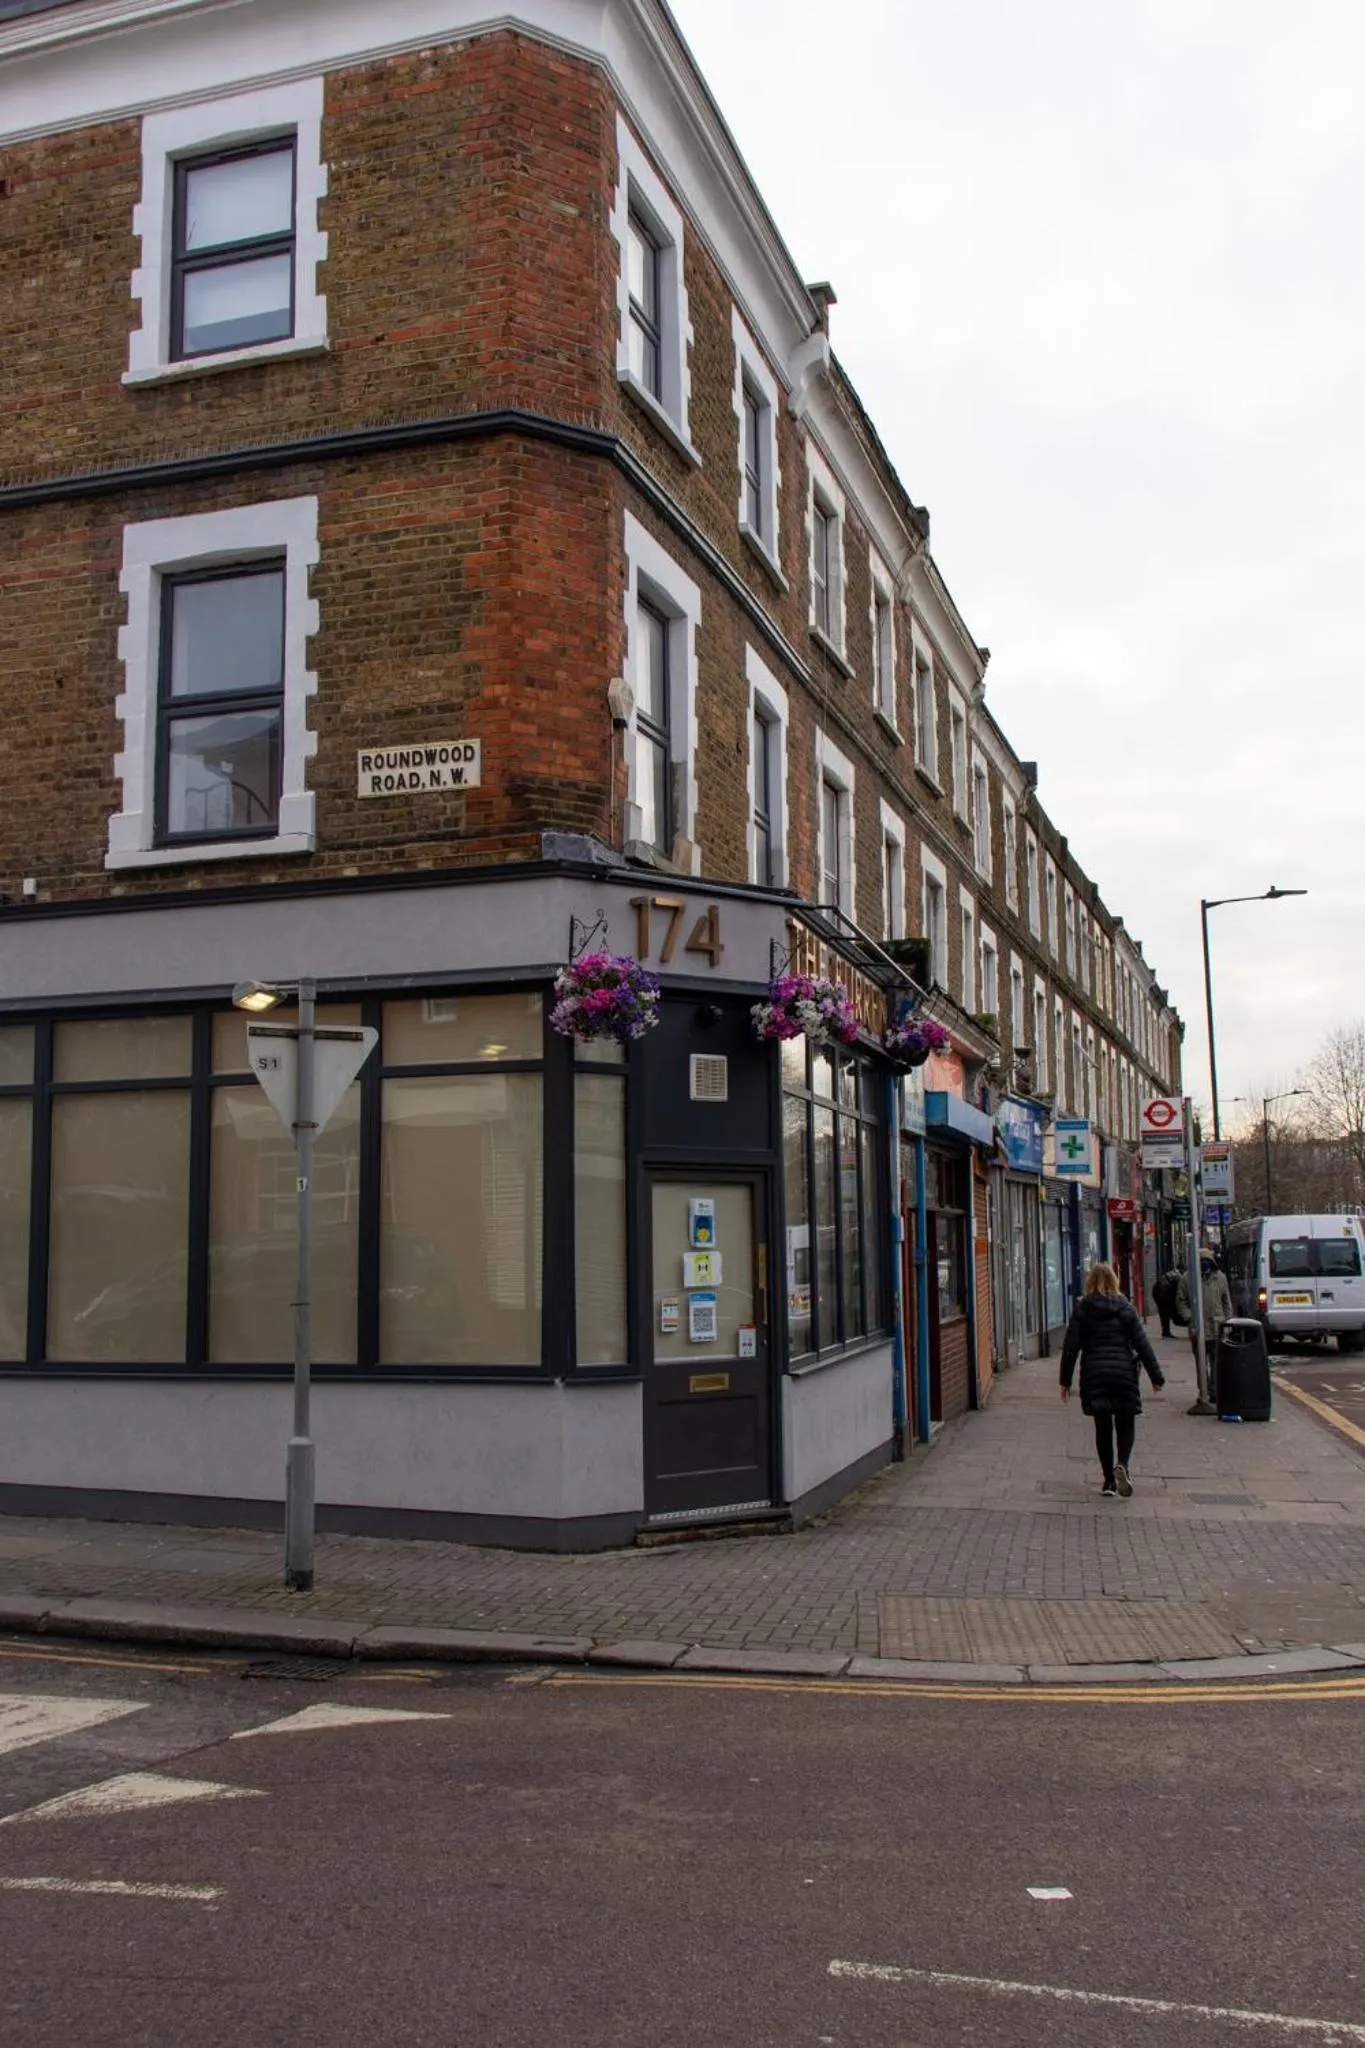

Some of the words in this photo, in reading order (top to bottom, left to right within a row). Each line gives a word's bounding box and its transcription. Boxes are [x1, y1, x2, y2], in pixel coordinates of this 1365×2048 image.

[361, 745, 475, 772] ROUNDWOOD
[629, 896, 724, 968] 174
[784, 916, 829, 981] THE
